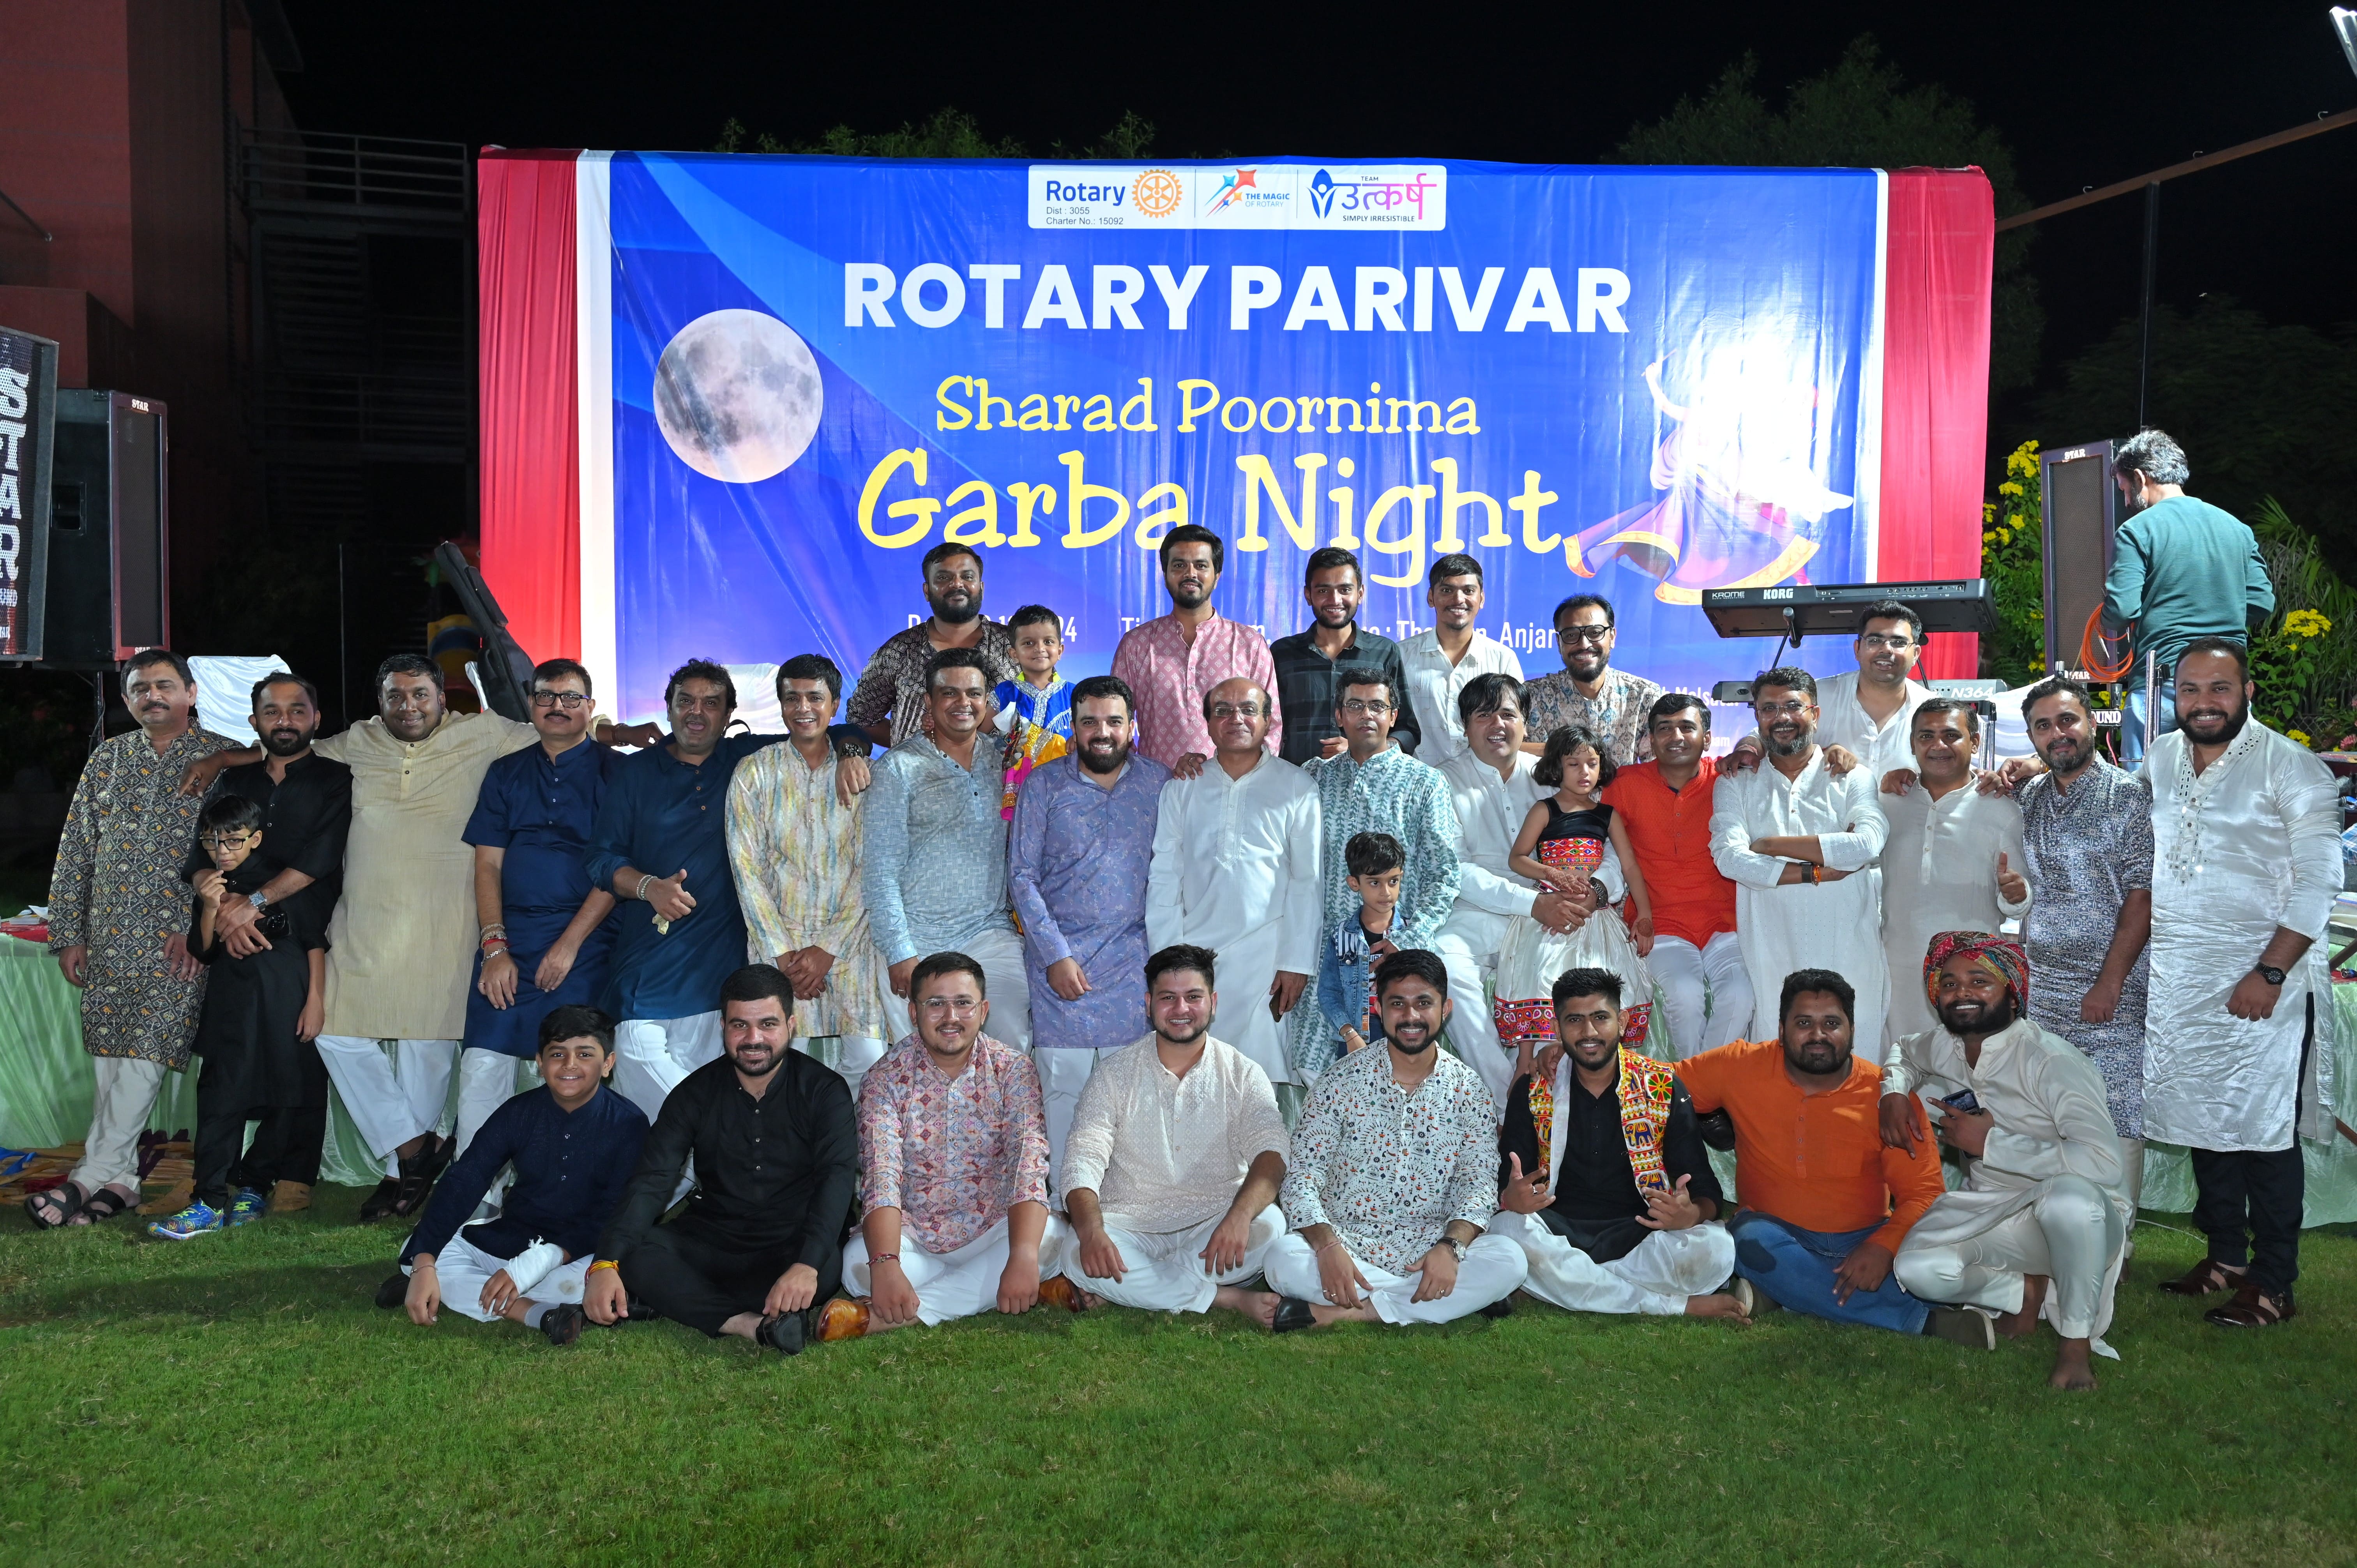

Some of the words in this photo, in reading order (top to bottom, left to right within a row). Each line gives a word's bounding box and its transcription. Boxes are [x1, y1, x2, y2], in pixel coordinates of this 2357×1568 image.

[1046, 180, 1126, 207] Rotary
[1333, 173, 1437, 220] उत्कर्ष
[1069, 207, 1090, 215] 3055
[1046, 217, 1077, 225] Charter
[844, 263, 1210, 330] ROTARY
[1230, 265, 1631, 334] PARIVAR
[132, 399, 148, 412] STAR
[936, 375, 1158, 432] Sharad
[1177, 379, 1481, 435] Poornima
[2064, 449, 2086, 460] STAR
[857, 447, 1189, 550] Garba
[1235, 452, 1562, 588] Night
[1763, 588, 1793, 600] KORG
[1951, 687, 1994, 698] N364
